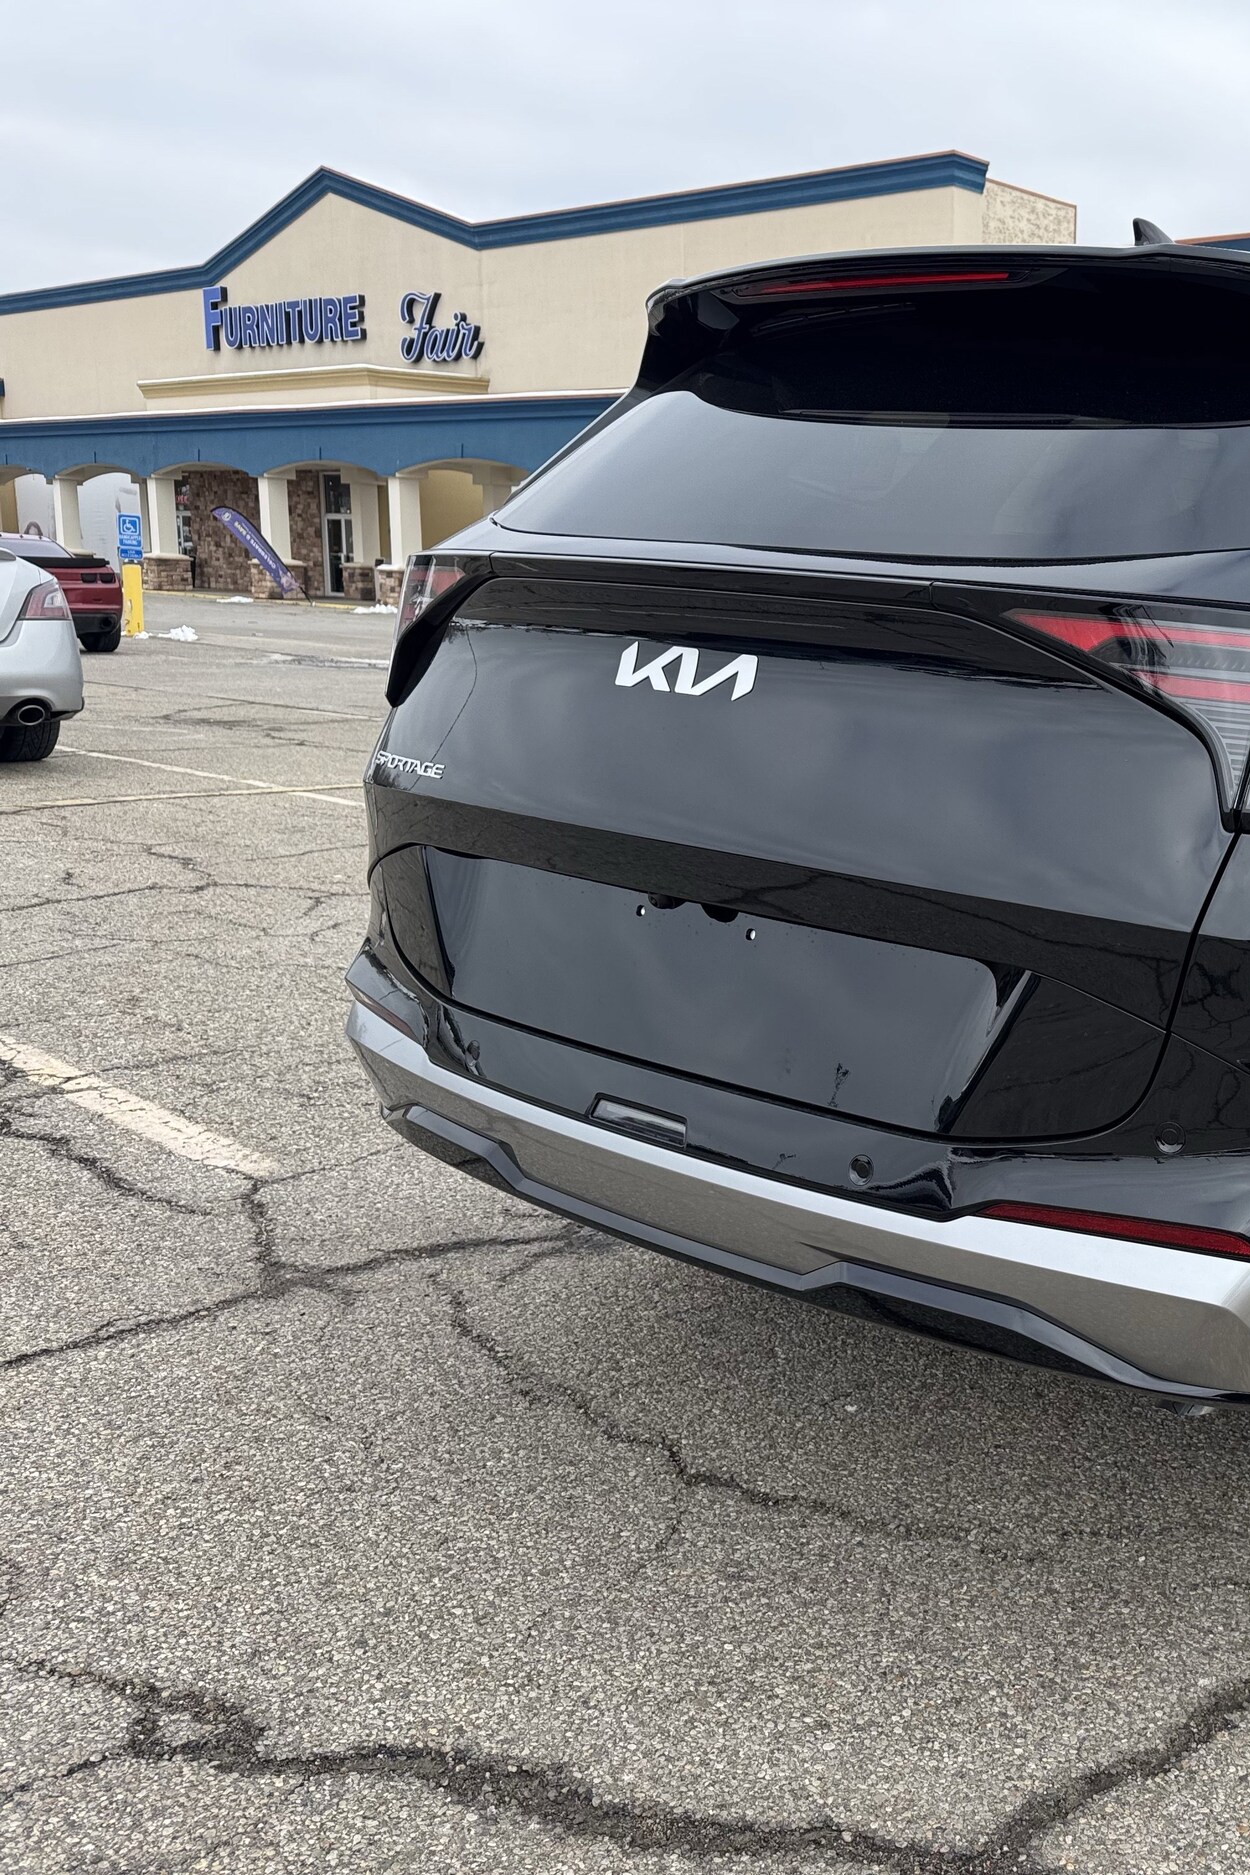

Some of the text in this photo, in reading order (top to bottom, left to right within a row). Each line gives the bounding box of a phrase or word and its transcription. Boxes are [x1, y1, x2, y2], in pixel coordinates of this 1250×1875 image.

[203, 286, 484, 363] FURNITURE Fair
[234, 521, 247, 536] SAVE
[250, 539, 276, 569] CELEBRATE
[615, 641, 759, 702] KIA
[375, 750, 445, 779] SPORTAGE
